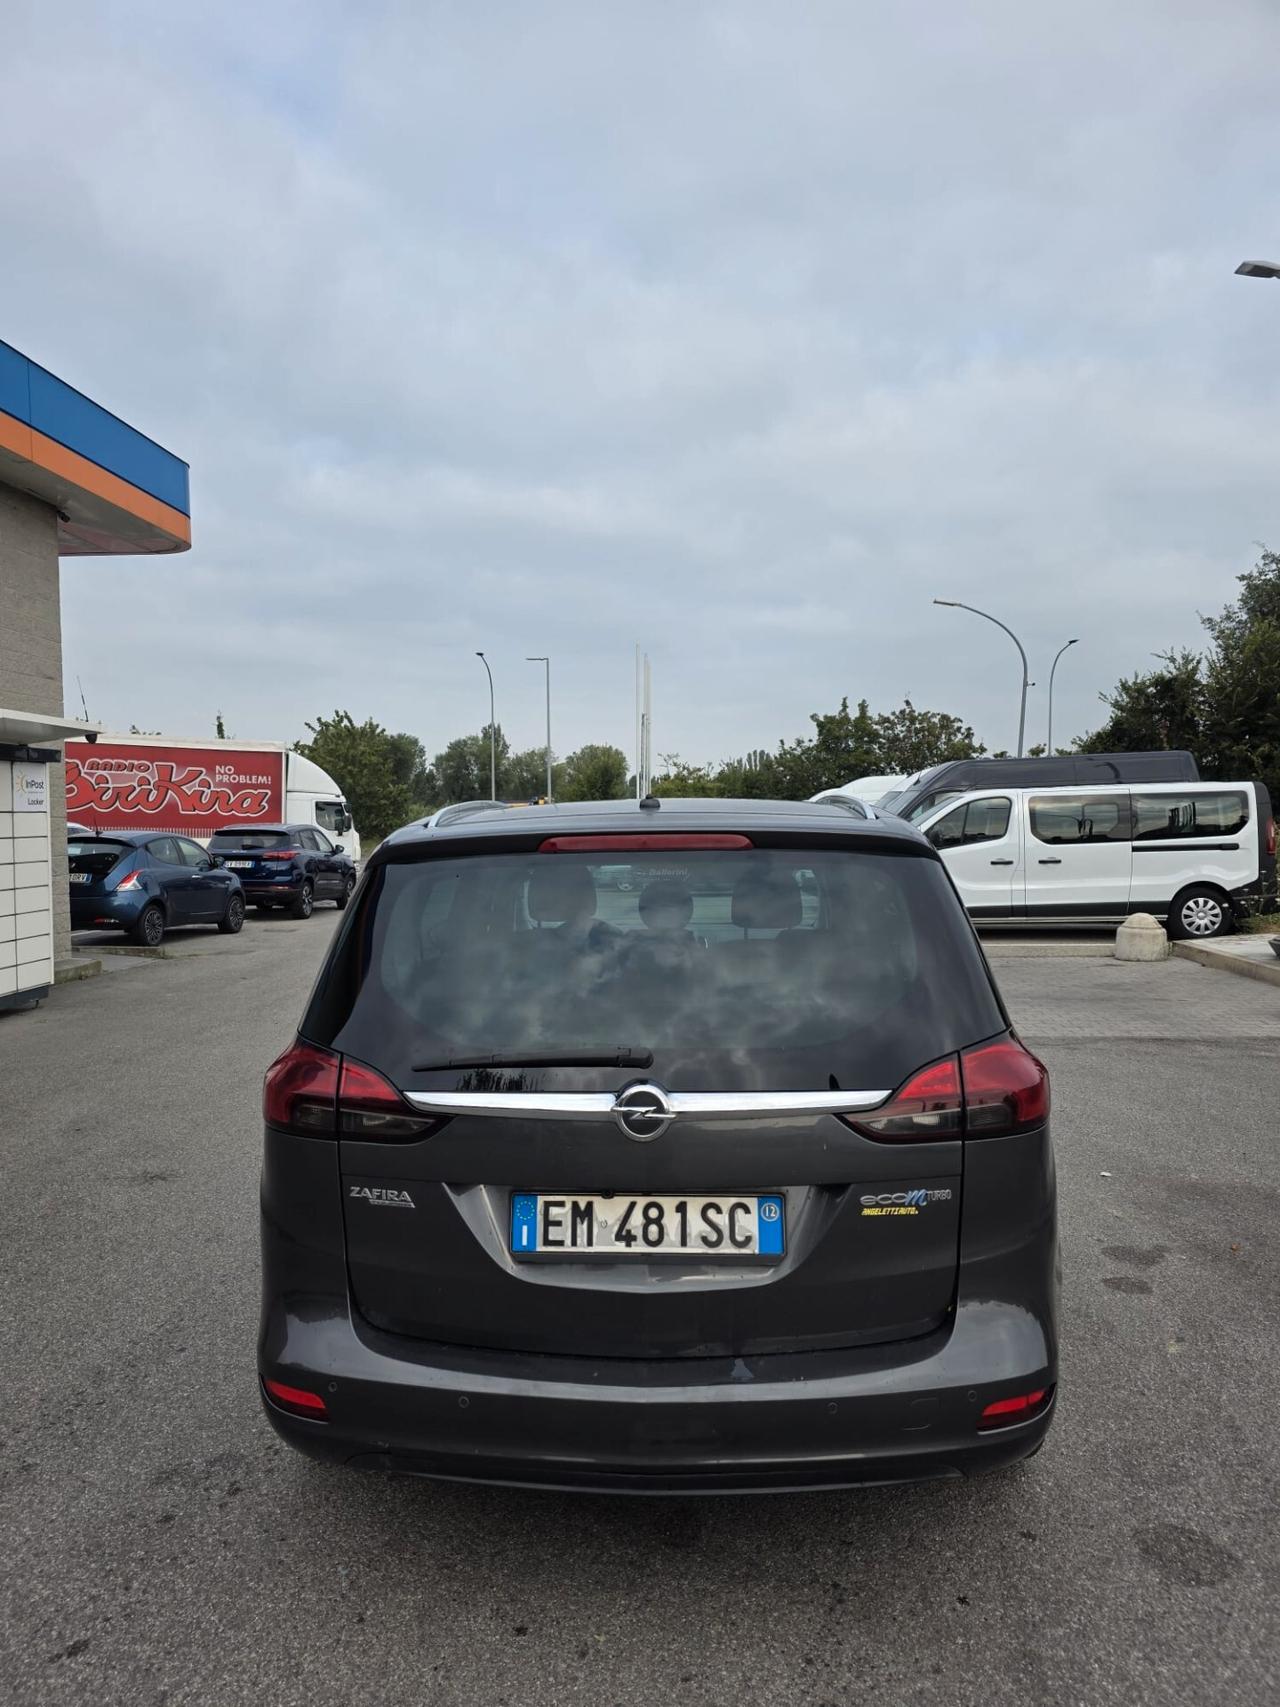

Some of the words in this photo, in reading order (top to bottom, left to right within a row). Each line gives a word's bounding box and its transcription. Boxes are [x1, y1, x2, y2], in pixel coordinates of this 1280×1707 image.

[86, 759, 150, 773] RADIO
[215, 765, 235, 775] NO
[25, 779, 45, 790] InPost
[215, 774, 271, 785] PROBLEM!
[349, 1186, 412, 1202] ZAFIRA
[926, 1189, 951, 1201] TURBO
[764, 1206, 777, 1217] 12
[542, 1200, 594, 1247] EM
[614, 1201, 752, 1248] 481SC
